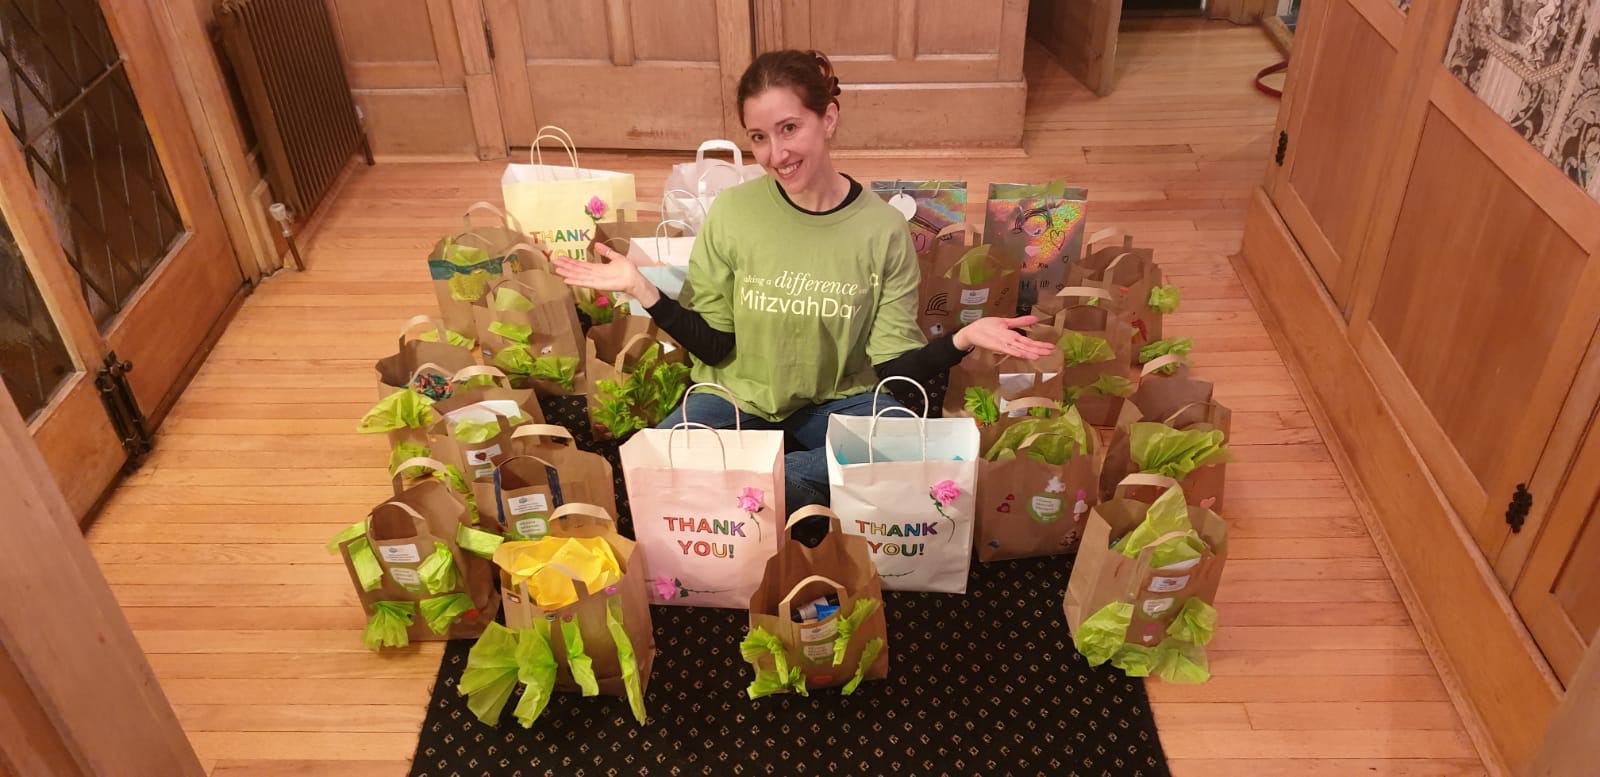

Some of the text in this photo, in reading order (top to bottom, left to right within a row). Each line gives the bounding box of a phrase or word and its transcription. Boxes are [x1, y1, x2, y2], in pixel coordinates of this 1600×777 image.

[529, 229, 592, 244] THANK
[542, 248, 585, 262] YOU!
[744, 275, 765, 286] aking
[775, 270, 858, 296] difference
[663, 516, 746, 537] THANK
[855, 519, 938, 537] THANK
[677, 540, 734, 559] YOU!
[867, 540, 925, 557] YOU!
